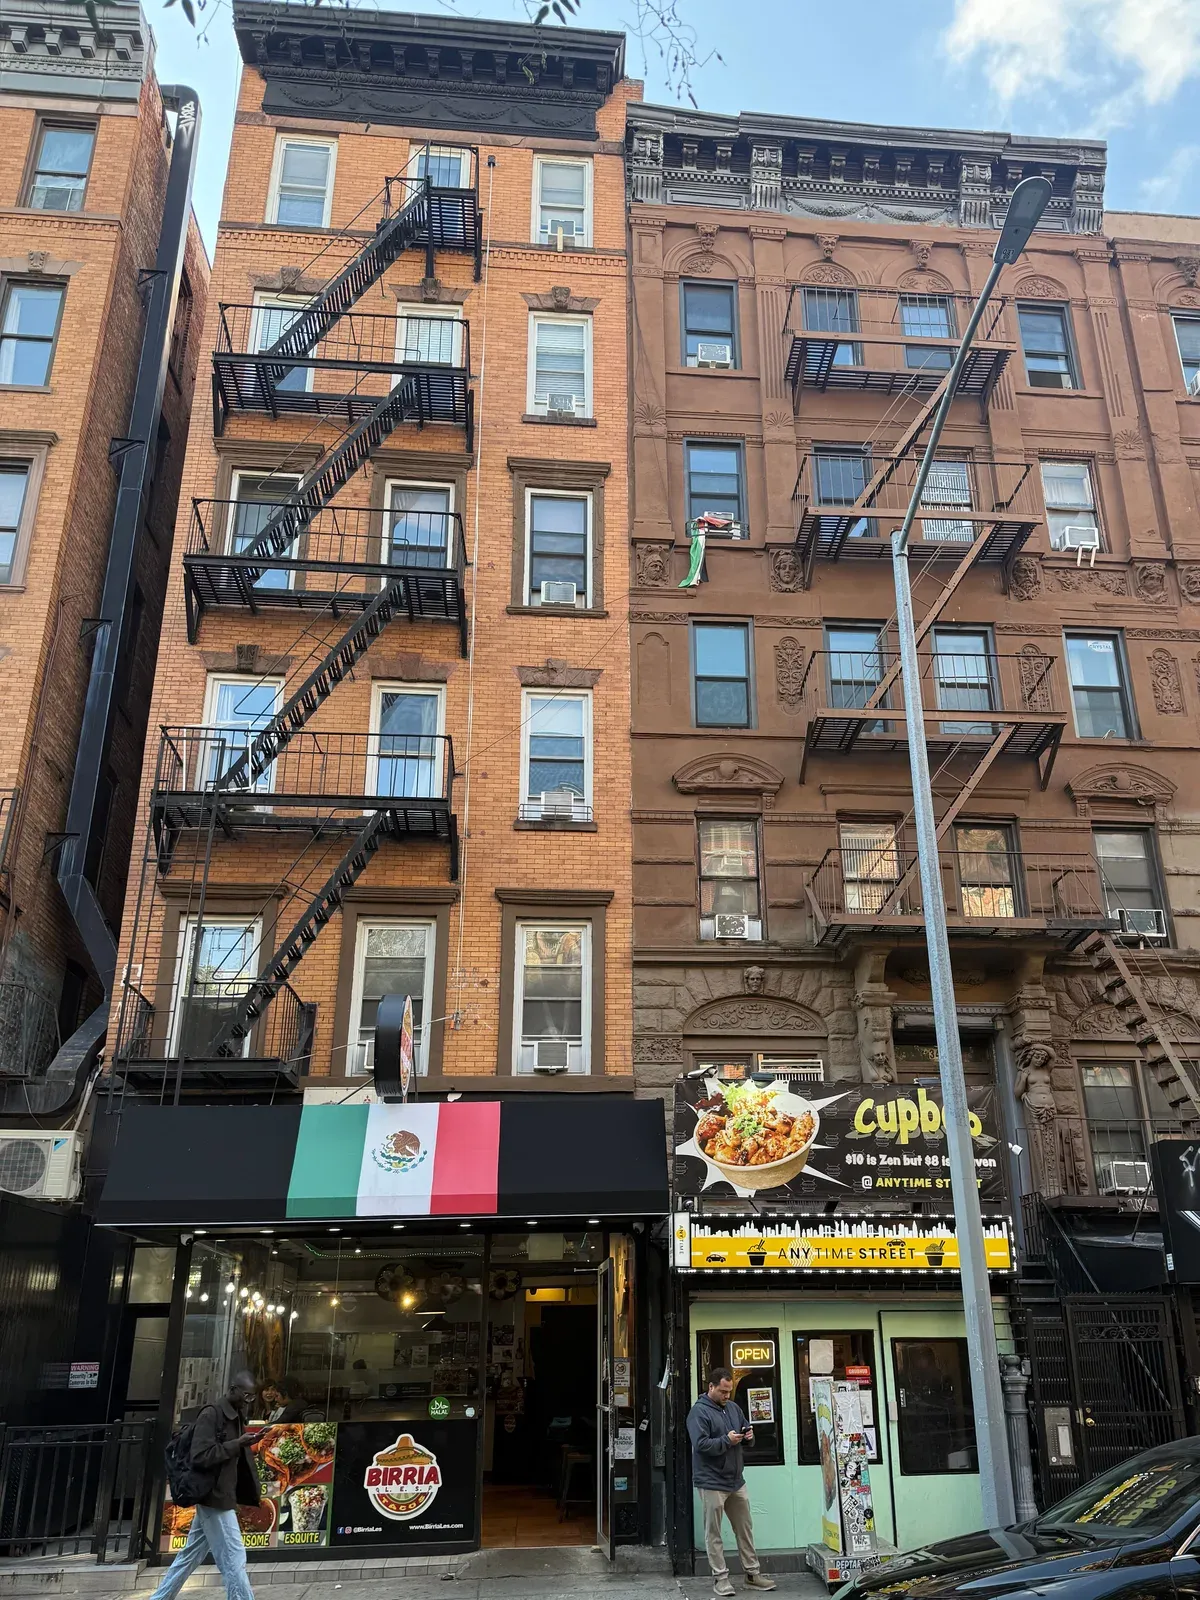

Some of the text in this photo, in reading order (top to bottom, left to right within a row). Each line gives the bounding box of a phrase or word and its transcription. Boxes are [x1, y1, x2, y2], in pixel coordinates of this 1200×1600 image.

[854, 1088, 982, 1144] Cupb
[845, 1153, 864, 1165] $10
[866, 1154, 877, 1166] is
[879, 1154, 901, 1166] Zen
[903, 1154, 922, 1167] but
[925, 1155, 939, 1167] $8
[876, 1178, 932, 1188] ANYTIME
[935, 1178, 983, 1189] STT
[778, 1248, 916, 1259] ANYTIME STREET
[735, 1348, 770, 1360] OPEN
[366, 1466, 440, 1487] BIRRIA
[381, 1495, 426, 1511] TACOS
[284, 1532, 320, 1544] ESQUITE
